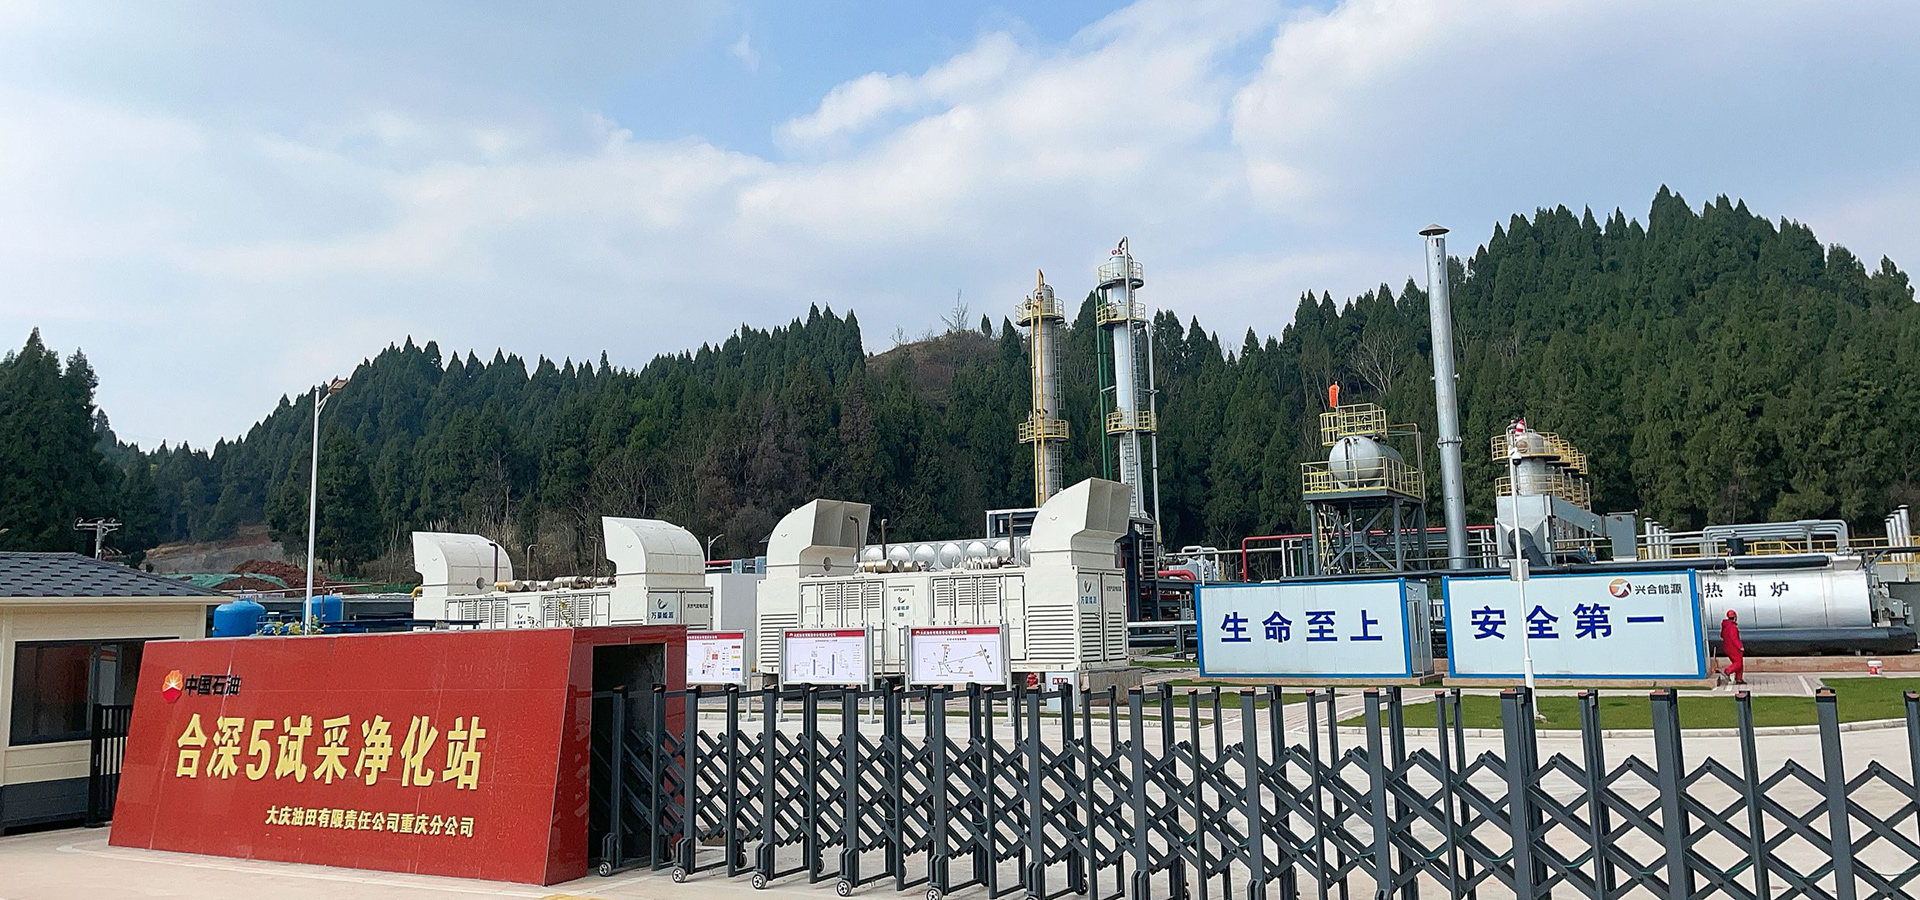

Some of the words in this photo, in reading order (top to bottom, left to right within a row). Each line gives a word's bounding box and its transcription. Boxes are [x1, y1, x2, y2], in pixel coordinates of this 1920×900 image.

[1634, 583, 1683, 595] 兴合能源
[1704, 581, 1789, 598] 热油炉
[1220, 609, 1383, 643] 生命至上
[1471, 603, 1665, 640] 安全第一
[184, 674, 241, 697] 中国石油
[176, 713, 487, 790] 合深5试采净化站
[265, 804, 475, 838] 大庆油田有限责任公司重庆分公司
